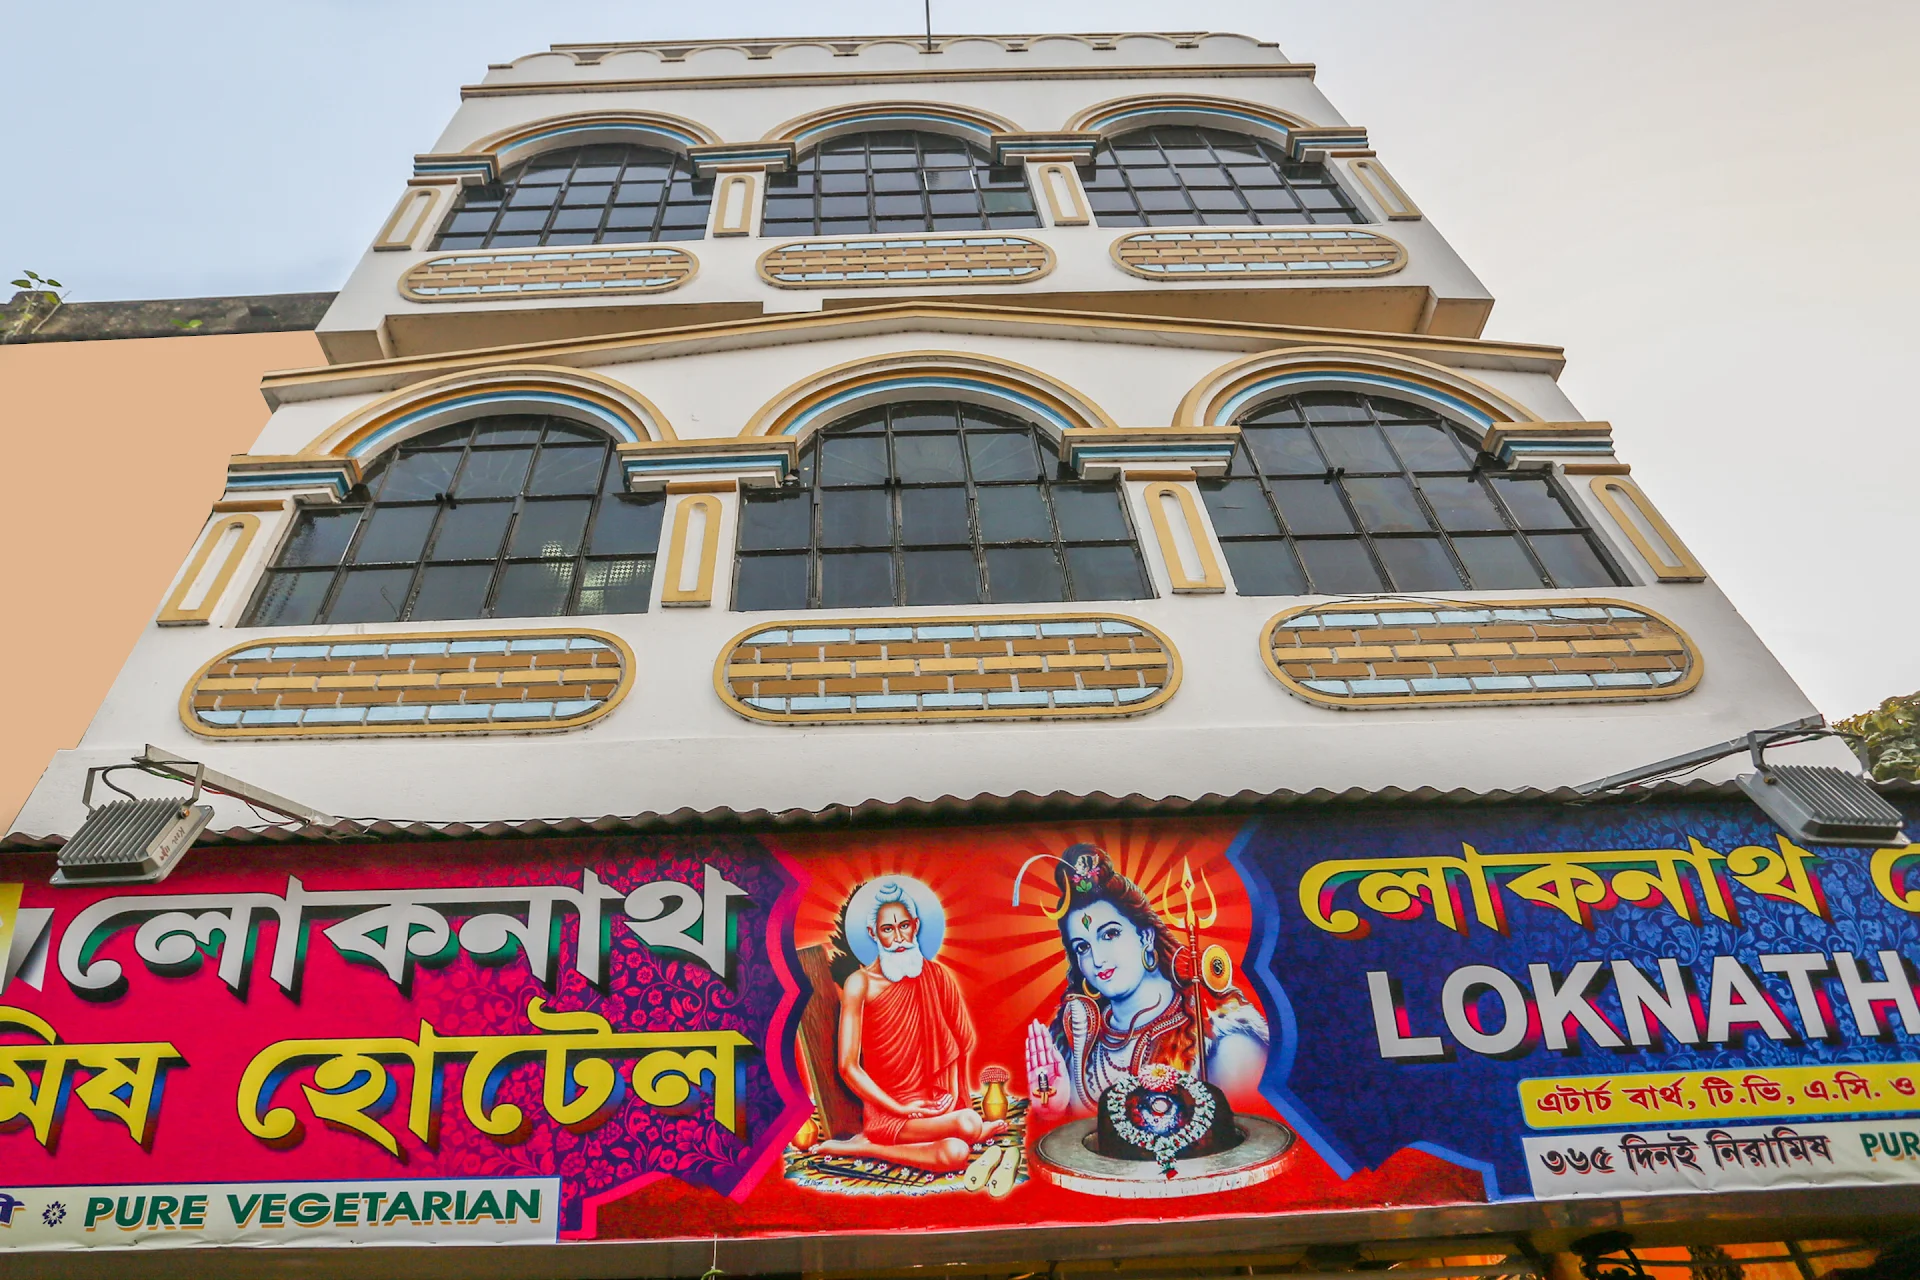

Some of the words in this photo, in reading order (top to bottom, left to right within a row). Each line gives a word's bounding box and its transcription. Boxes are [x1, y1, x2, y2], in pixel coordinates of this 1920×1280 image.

[1299, 833, 1819, 934] লোকনাথ
[57, 863, 750, 993] লোকনাথ
[1367, 949, 1920, 1059] LOKNATH
[237, 997, 754, 1158] হোটেল
[1888, 1077, 1916, 1096] ও
[1540, 1147, 1615, 1174] ৩৬৫
[1618, 1132, 1703, 1174] দিনই
[1705, 1126, 1833, 1168] নিরামিষ
[1859, 1131, 1920, 1159] PUR
[83, 1195, 208, 1229] PURE
[226, 1190, 541, 1228] VEGETARIAN
